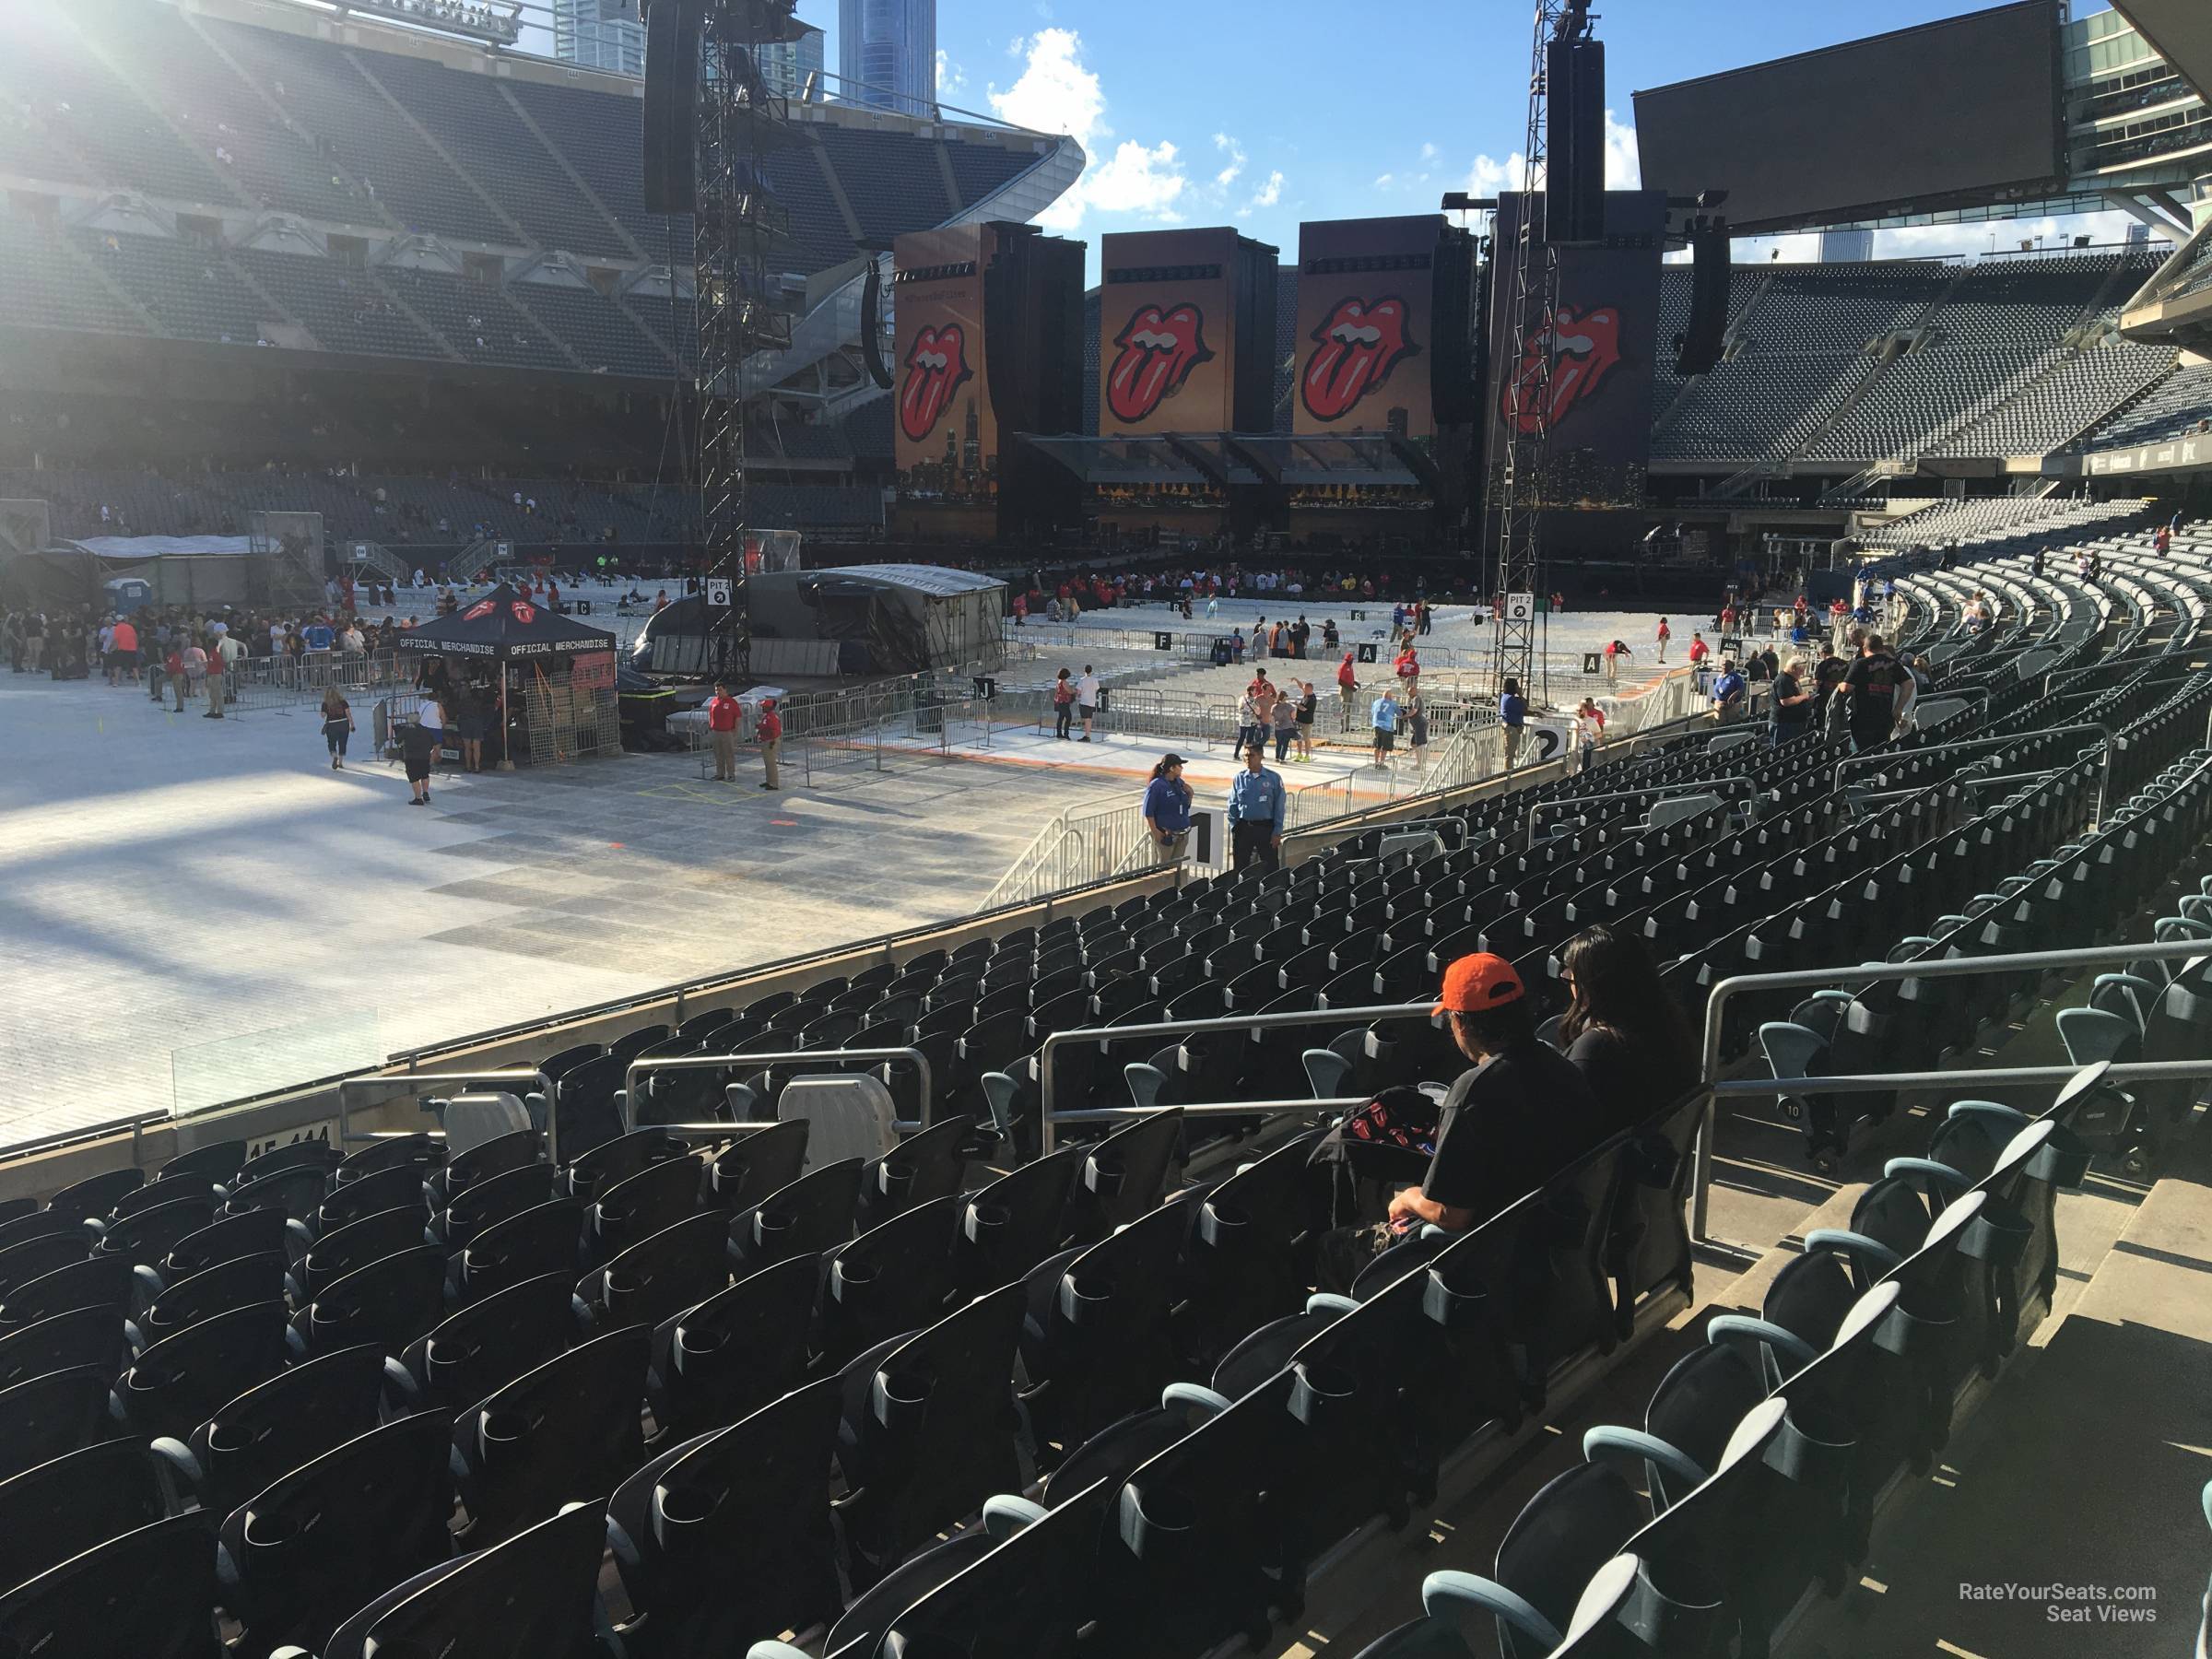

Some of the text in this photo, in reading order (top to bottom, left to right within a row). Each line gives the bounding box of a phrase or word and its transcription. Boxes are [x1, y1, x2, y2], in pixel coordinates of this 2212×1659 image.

[710, 582, 724, 590] PIT
[1511, 595, 1532, 604] PIT 2
[581, 603, 587, 614] C
[1173, 604, 1180, 612] B
[399, 638, 438, 650] OFFICIAL
[441, 641, 495, 655] MERCHANDISE
[511, 639, 608, 655] OFFICIAL MERCHANDISE
[1159, 635, 1167, 647] F
[1362, 647, 1371, 660] A
[1586, 656, 1595, 670] A
[980, 682, 989, 699] J
[1382, 702, 1389, 712] 7
[1788, 1105, 1799, 1117] 10
